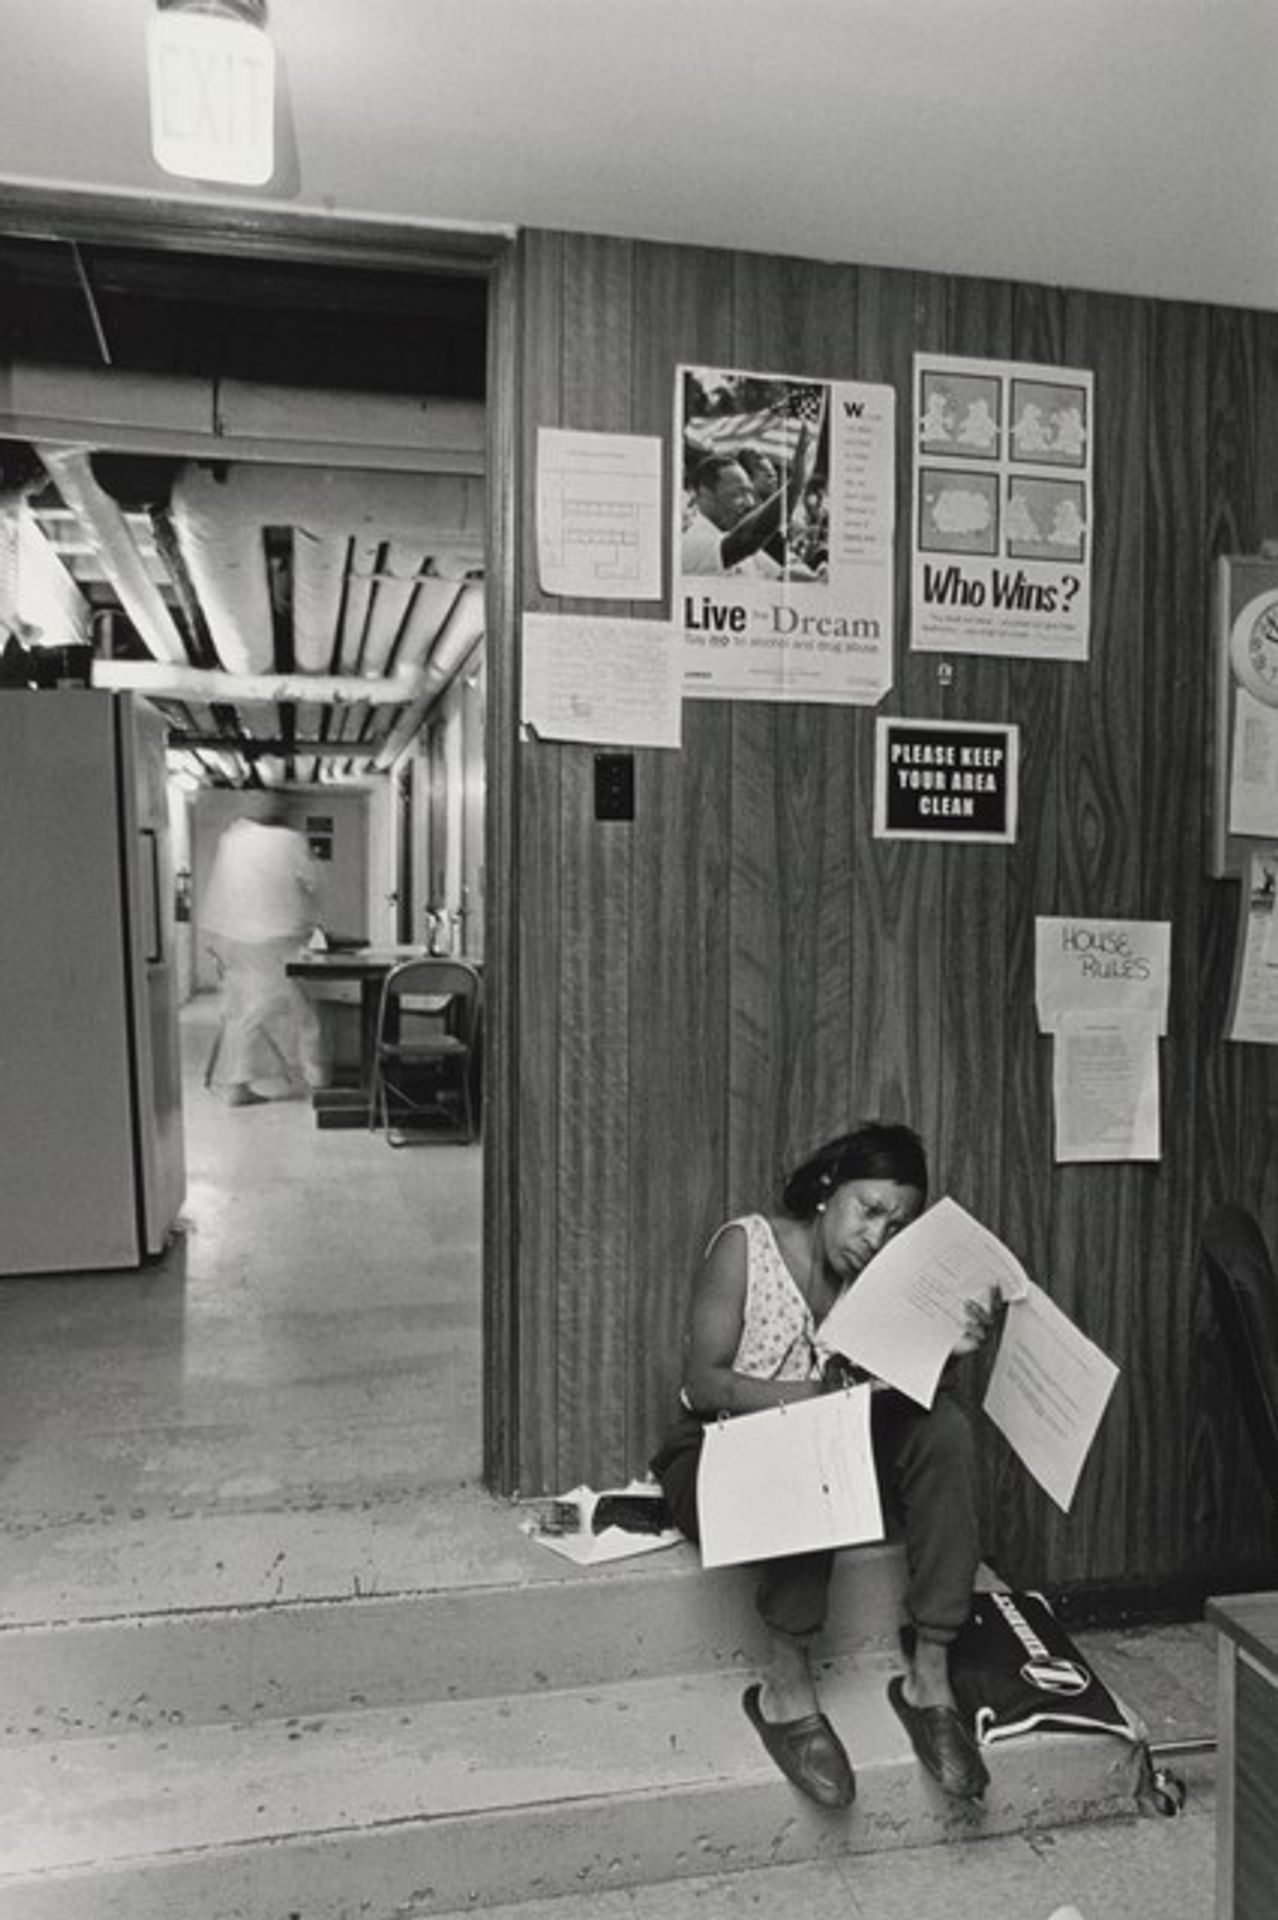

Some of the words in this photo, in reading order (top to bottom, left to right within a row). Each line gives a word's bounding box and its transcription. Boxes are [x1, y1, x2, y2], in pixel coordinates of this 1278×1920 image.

[159, 42, 263, 147] EXIT
[924, 565, 985, 607] Who
[992, 568, 1080, 613] Wins?
[685, 596, 746, 632] Live
[773, 606, 880, 638] Dream
[891, 743, 955, 766] PLEASE
[960, 746, 1003, 767] KEEP
[898, 769, 947, 790] YOUR
[951, 771, 997, 792] AREA
[918, 795, 974, 817] CLEAN
[1062, 926, 1133, 957] HOUSE
[1078, 953, 1151, 980] RULES
